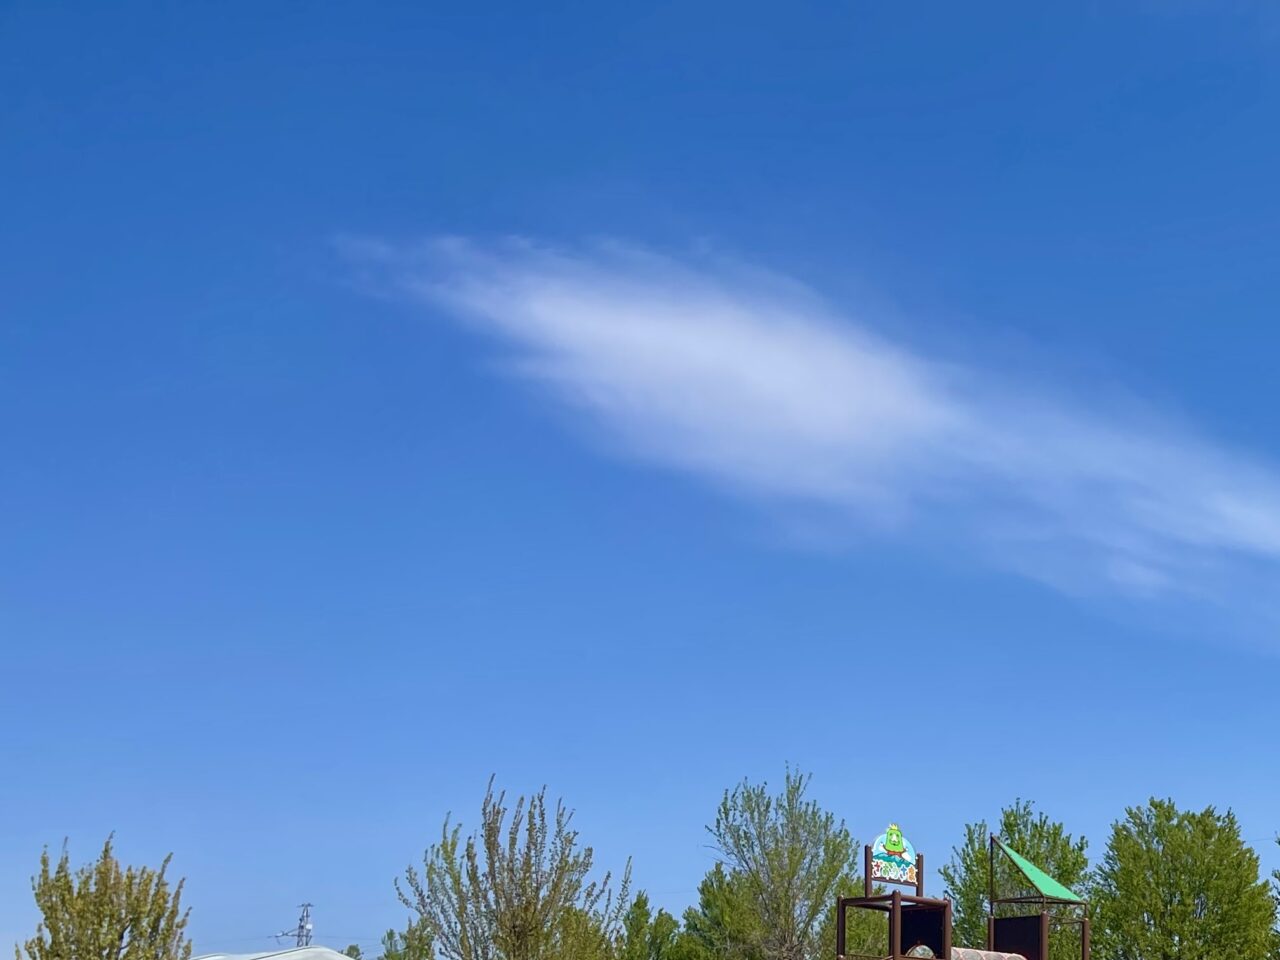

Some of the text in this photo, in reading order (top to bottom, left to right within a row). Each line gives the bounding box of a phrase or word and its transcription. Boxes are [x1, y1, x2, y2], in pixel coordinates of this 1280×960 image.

[873, 861, 916, 882] ざおうさま
